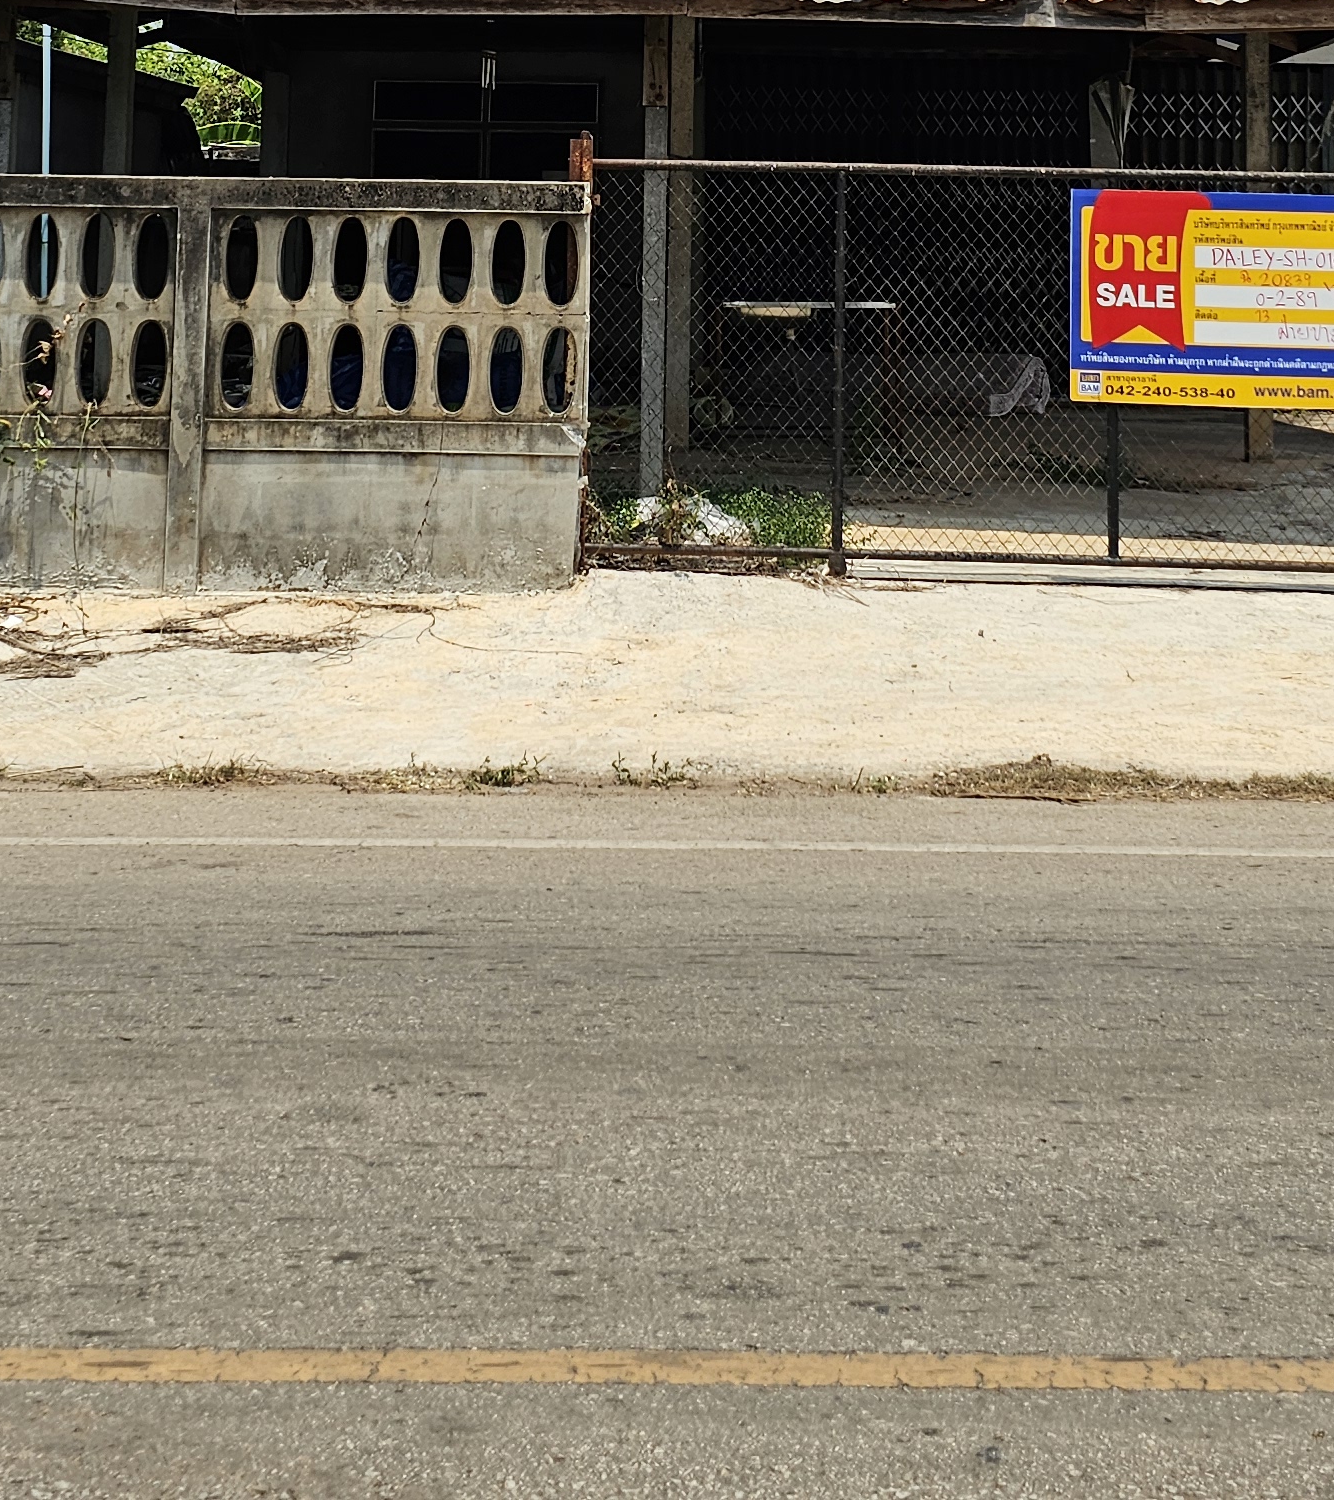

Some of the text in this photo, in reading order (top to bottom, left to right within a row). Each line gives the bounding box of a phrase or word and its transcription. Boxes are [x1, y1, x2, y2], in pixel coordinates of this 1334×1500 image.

[1094, 232, 1178, 273] ขาย
[1096, 282, 1176, 309] SALE
[1081, 383, 1100, 392] BAM
[1105, 384, 1236, 399] 042-240-538-40
